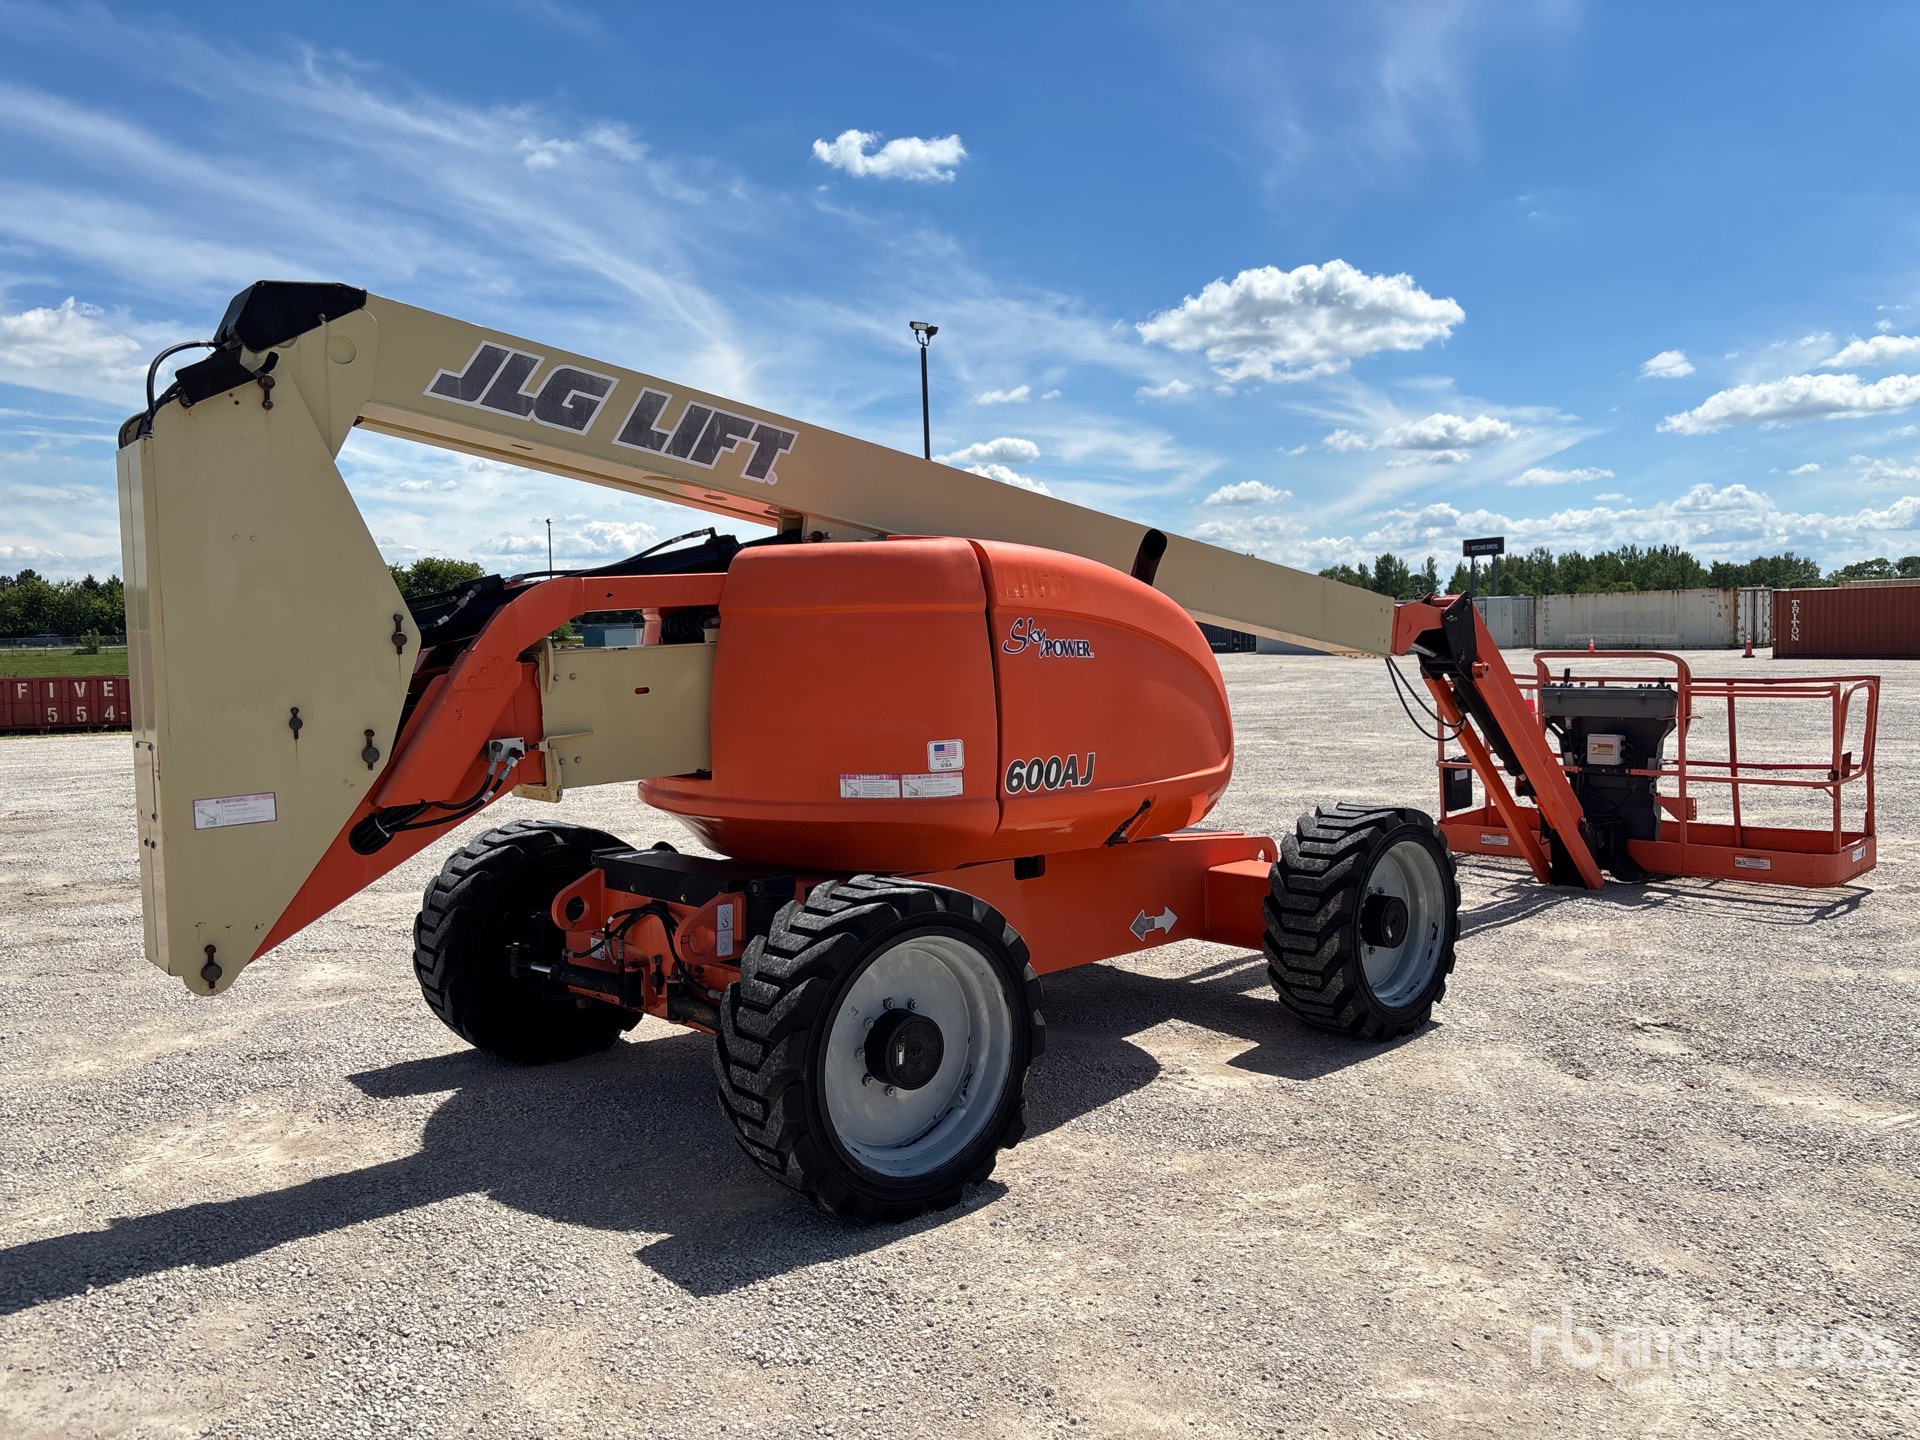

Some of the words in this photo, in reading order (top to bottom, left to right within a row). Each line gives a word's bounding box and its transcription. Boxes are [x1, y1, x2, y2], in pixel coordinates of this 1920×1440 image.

[422, 339, 620, 437] JLG
[611, 386, 800, 484] LIFT
[1002, 617, 1047, 658] Sky
[1791, 599, 1800, 641] TRITON
[1044, 639, 1092, 658] POWER
[17, 680, 115, 699] FIVE
[1004, 752, 1096, 795] 600AJ
